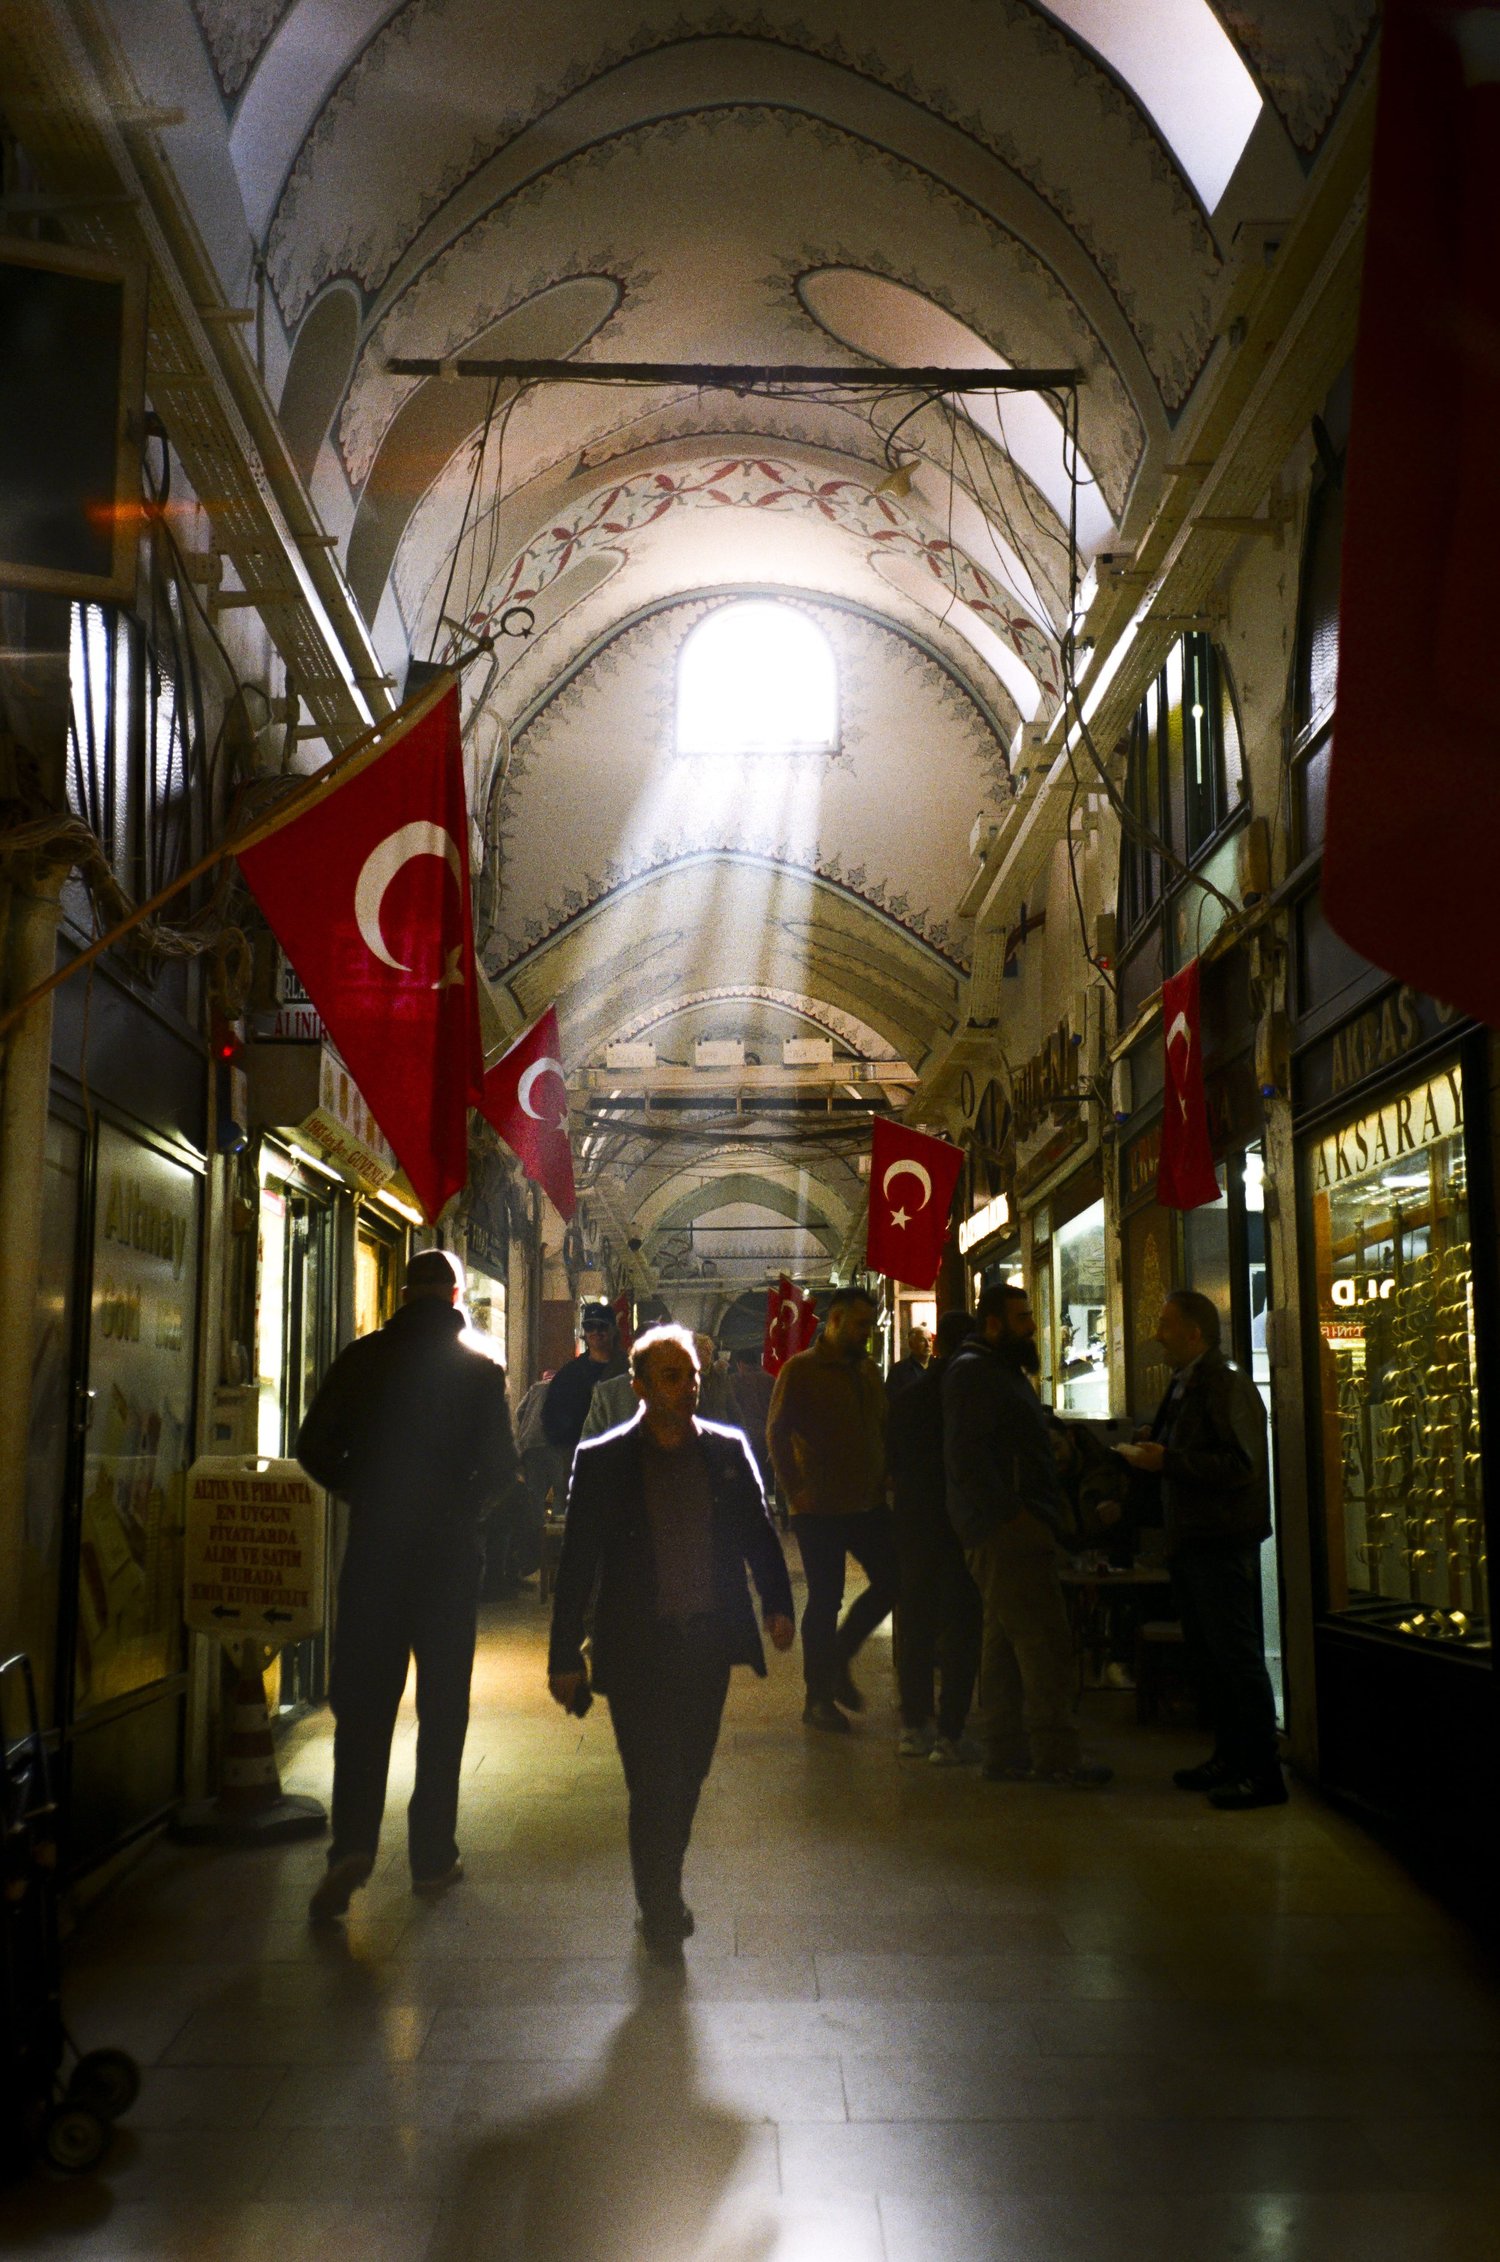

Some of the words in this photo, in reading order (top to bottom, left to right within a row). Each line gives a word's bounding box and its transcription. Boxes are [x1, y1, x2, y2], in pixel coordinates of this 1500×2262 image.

[1316, 1067, 1465, 1190] AKSARAY
[194, 1479, 229, 1500] ALTIN
[232, 1480, 249, 1501] VE
[252, 1481, 312, 1504] PIRLANTA
[216, 1504, 236, 1521] EN
[240, 1505, 292, 1523] UYGUN
[203, 1545, 237, 1563] ALIM
[242, 1547, 259, 1565] VE
[261, 1549, 302, 1567] SATIM
[221, 1567, 283, 1586] BURADA
